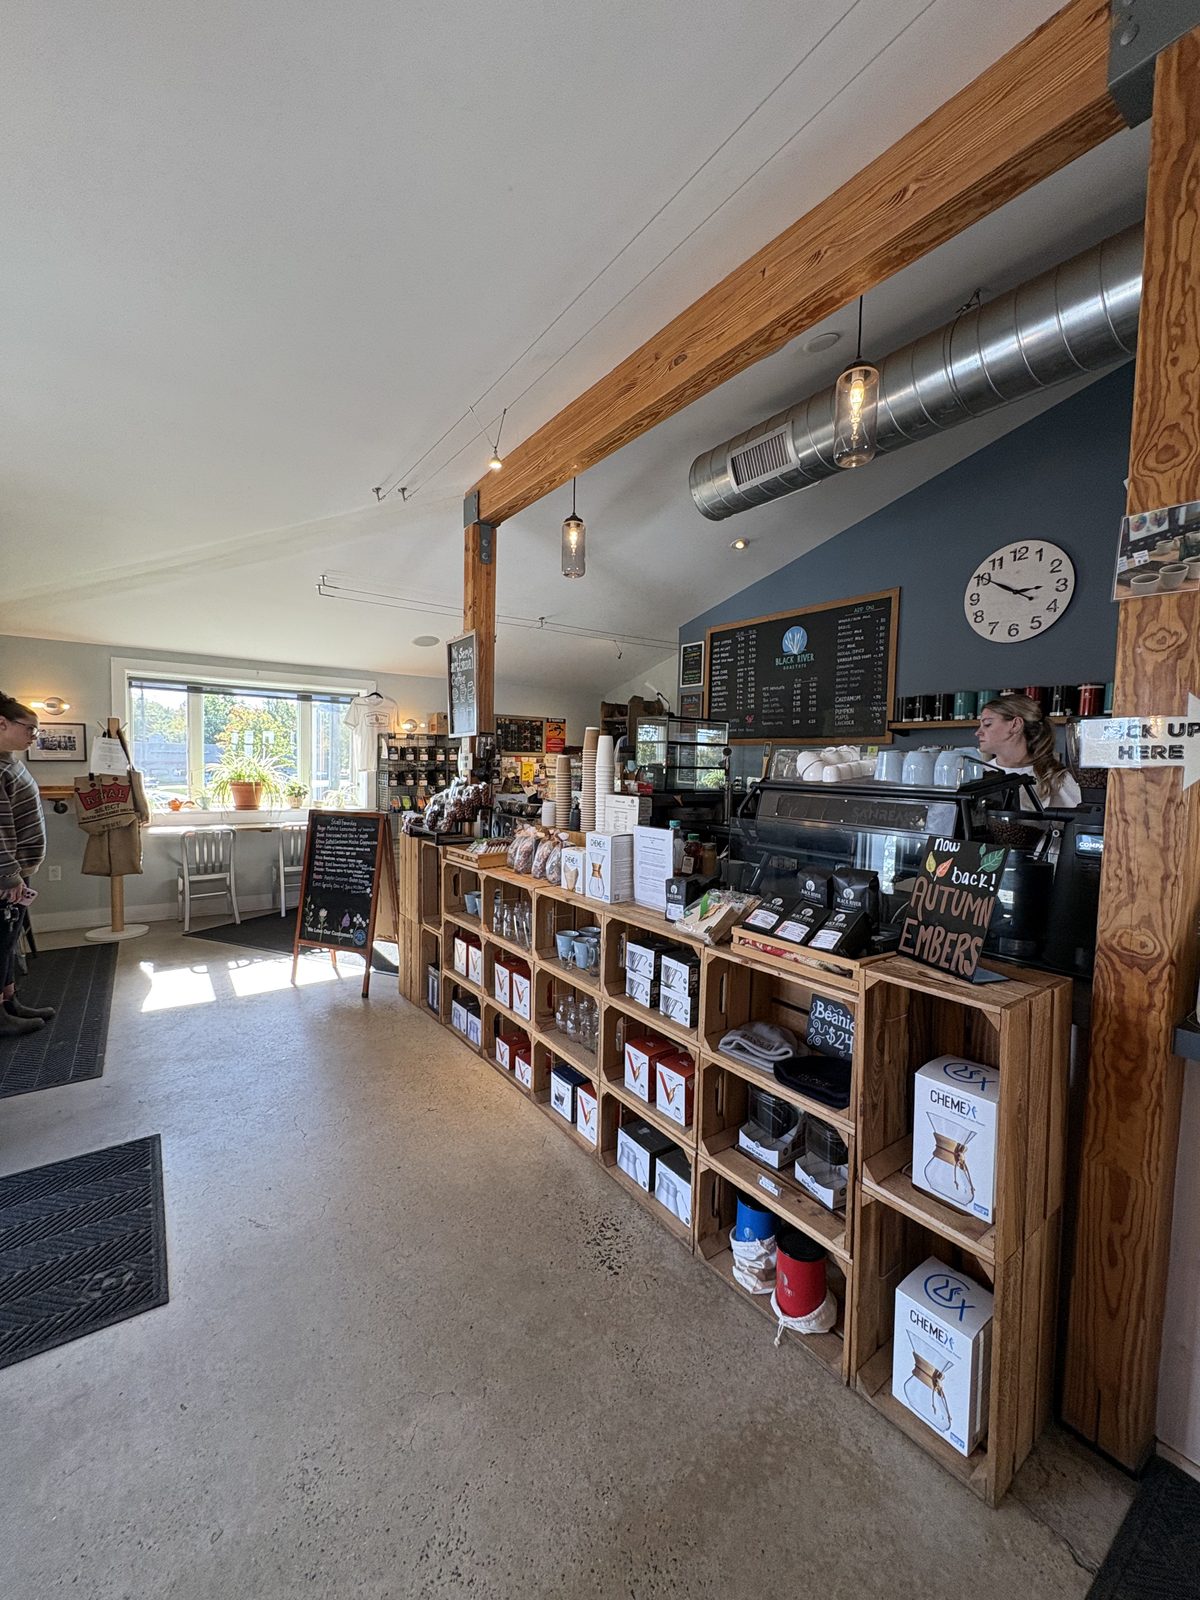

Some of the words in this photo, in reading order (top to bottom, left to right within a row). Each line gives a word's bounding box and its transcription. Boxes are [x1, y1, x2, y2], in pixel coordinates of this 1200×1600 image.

[1010, 546, 1029, 562] 12
[1036, 548, 1044, 562] 1
[989, 556, 1004, 571] 11
[1050, 558, 1062, 574] 2
[974, 572, 991, 587] 10
[1056, 578, 1068, 592] 3
[970, 592, 980, 606] 9
[1046, 598, 1059, 612] 4
[974, 610, 984, 623] 8
[1030, 616, 1042, 630] 5
[988, 621, 1000, 635] 7
[1008, 624, 1019, 637] 6
[775, 656, 794, 666] BLACK
[797, 653, 815, 662] RIVER
[1104, 723, 1158, 739] CK
[1167, 722, 1200, 738] UP
[1118, 744, 1185, 761] HERE
[952, 866, 996, 891] back!
[911, 876, 995, 928] AUTUMN
[898, 917, 984, 976] EMBERS
[930, 1089, 978, 1119] CHEMEX
[909, 1309, 955, 1350] CHEMEX
